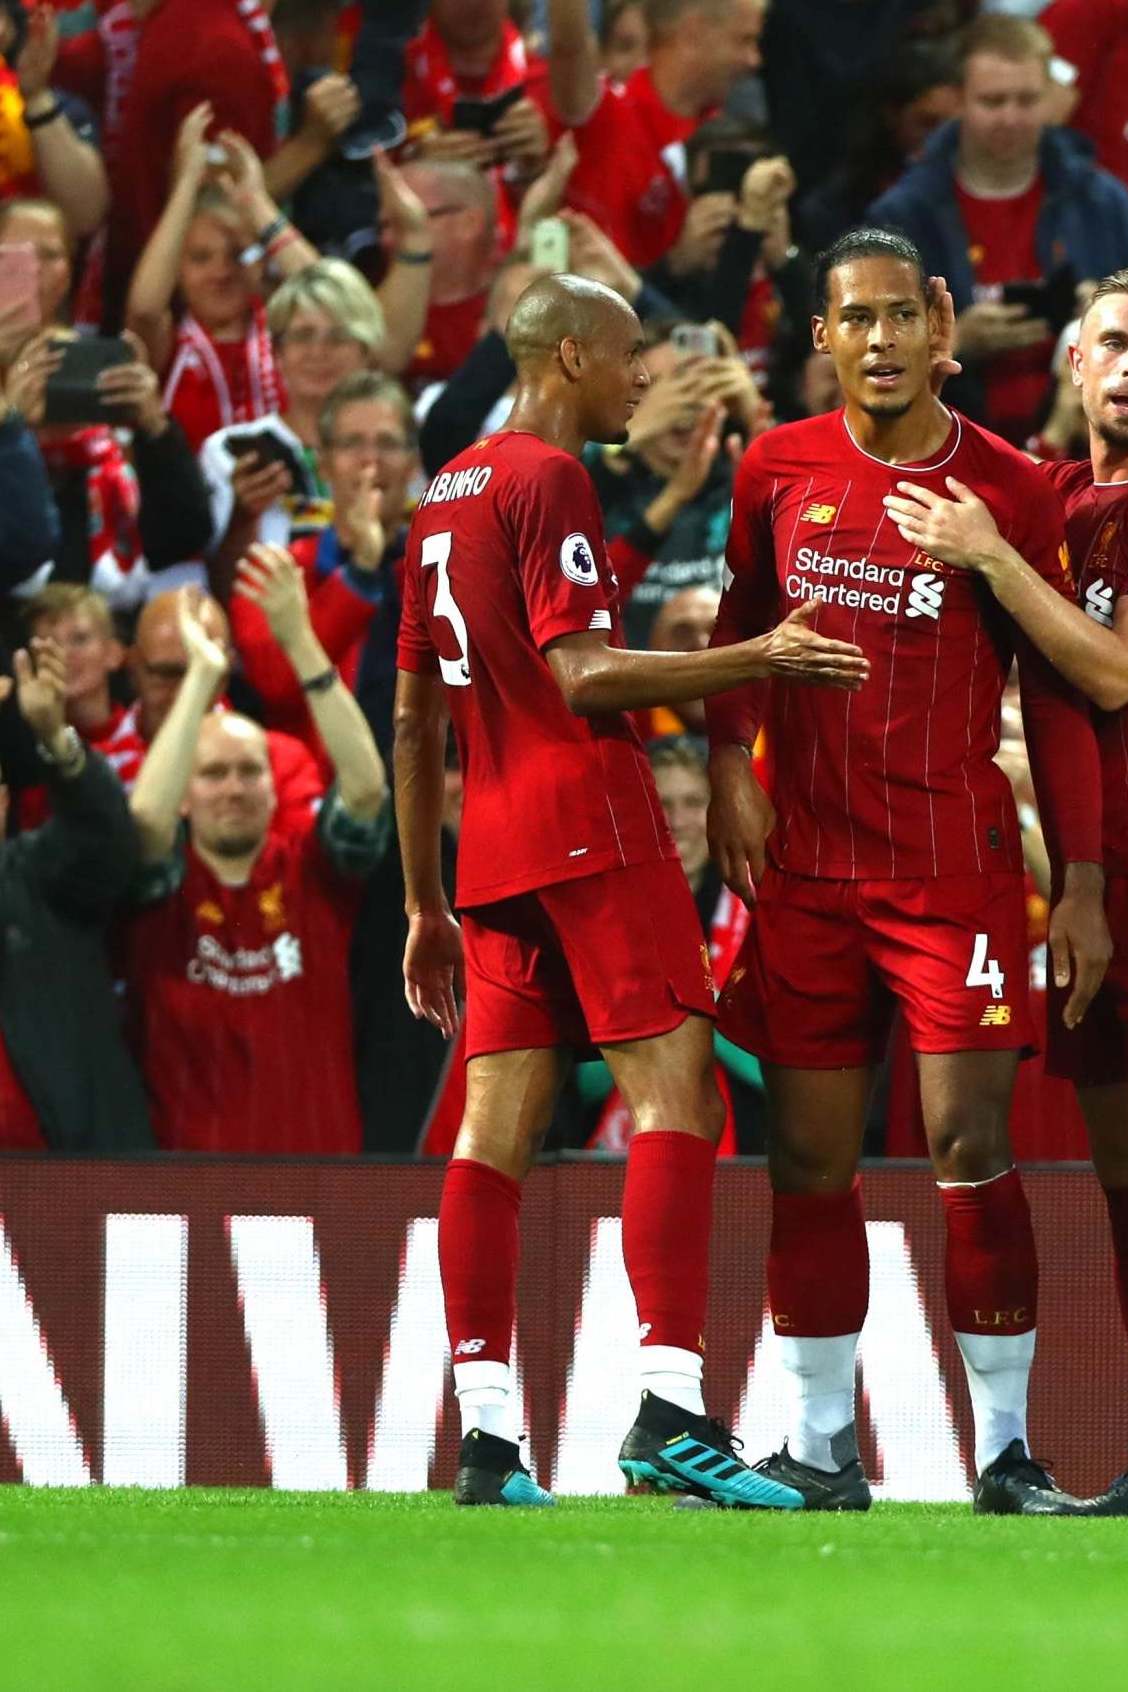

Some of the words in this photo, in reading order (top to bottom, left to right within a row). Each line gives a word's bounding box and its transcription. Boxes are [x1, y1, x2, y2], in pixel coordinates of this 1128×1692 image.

[418, 466, 493, 511] ABINHO
[795, 547, 905, 588] Standard
[421, 531, 472, 687] 3
[785, 574, 901, 615] Chartered
[965, 933, 1005, 999] 4
